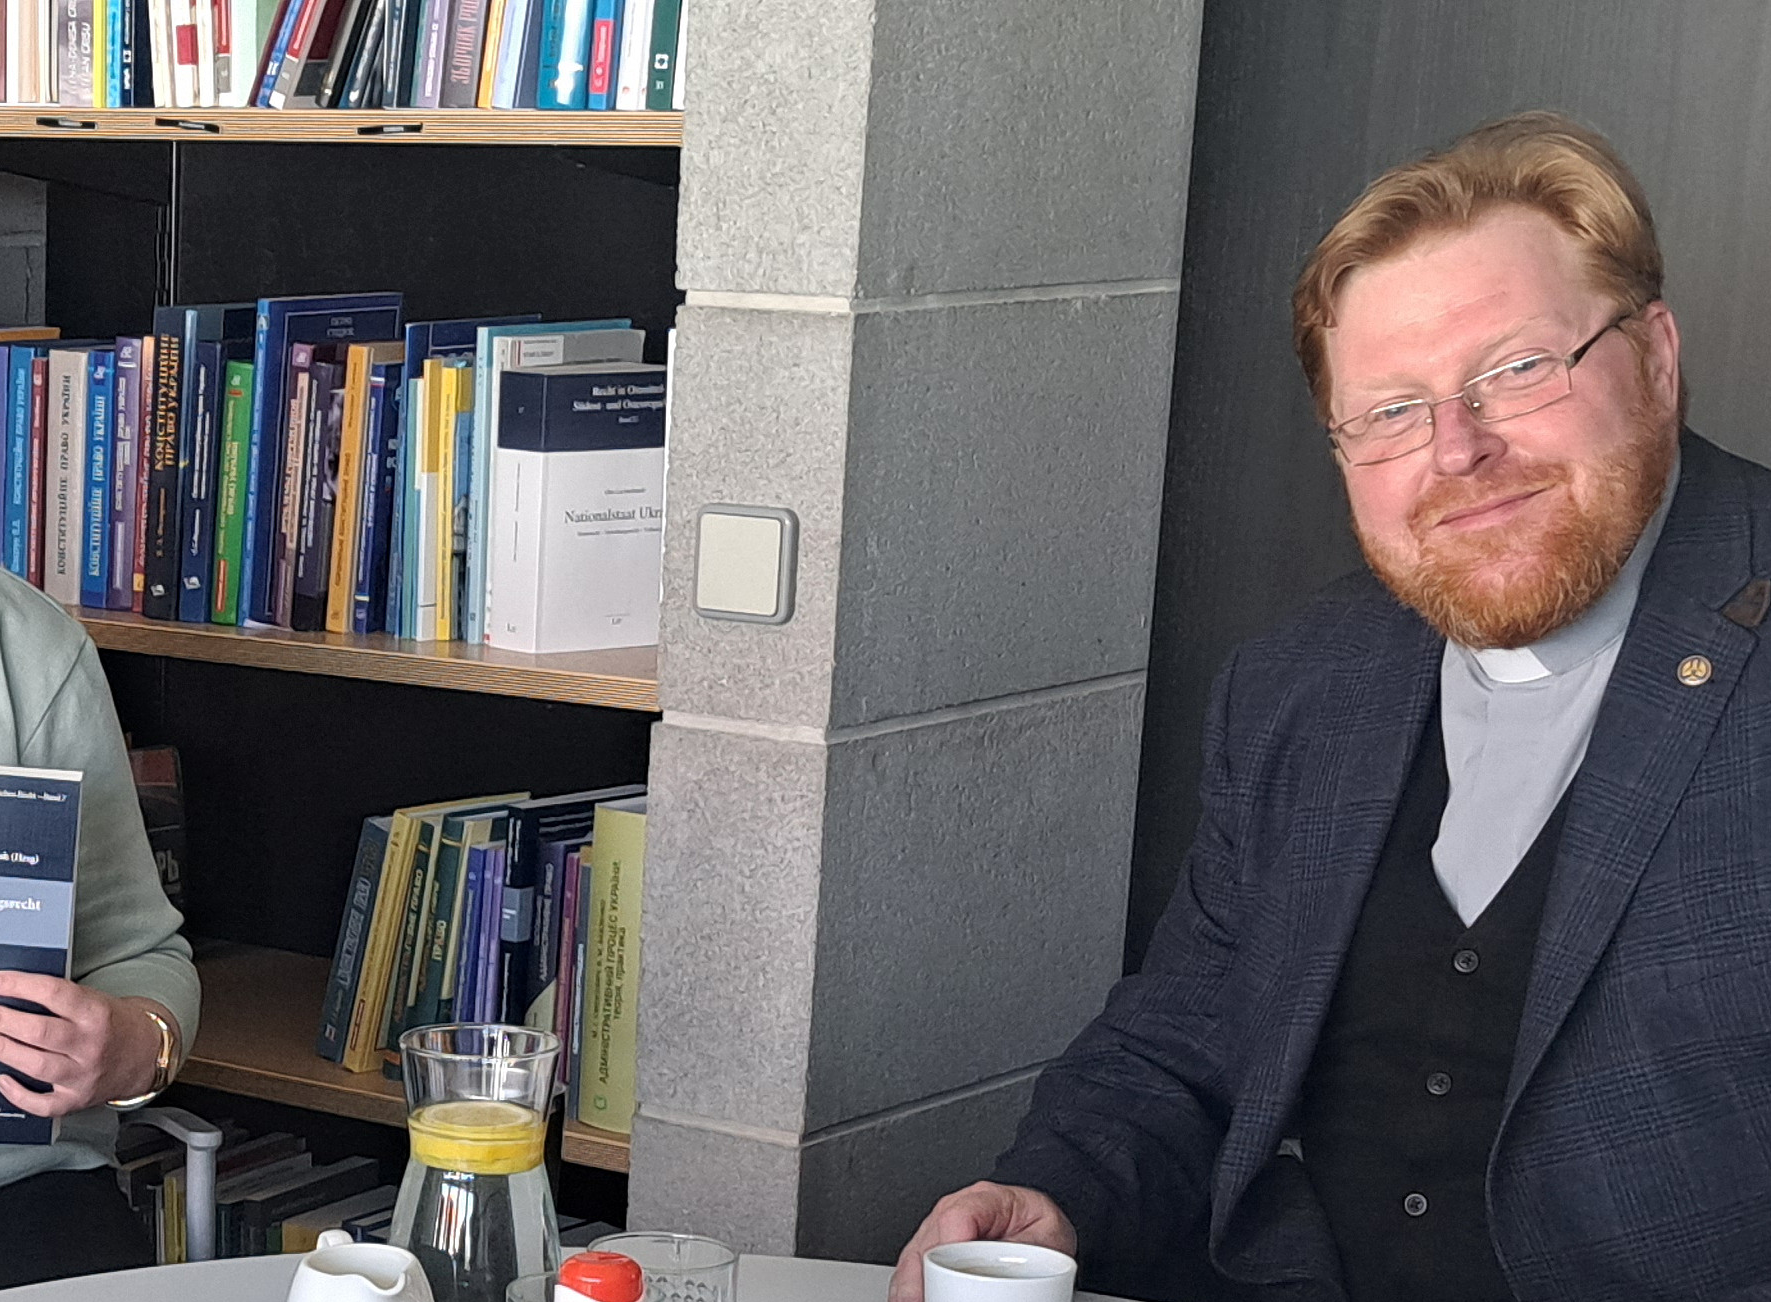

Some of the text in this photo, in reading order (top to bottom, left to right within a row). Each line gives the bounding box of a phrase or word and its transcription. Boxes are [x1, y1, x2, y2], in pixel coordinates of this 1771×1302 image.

[93, 445, 104, 481] ПРАВО
[164, 412, 176, 466] ПРАВО
[57, 374, 71, 575] КОНСТИТУЦІЙНЕ ПРАВО УКРАЇНИ
[564, 507, 636, 523] Nationalstaat
[606, 914, 617, 963] ПРОЦЕС
[599, 965, 615, 1084] АДМІНІСТРАТИВНИЙ
